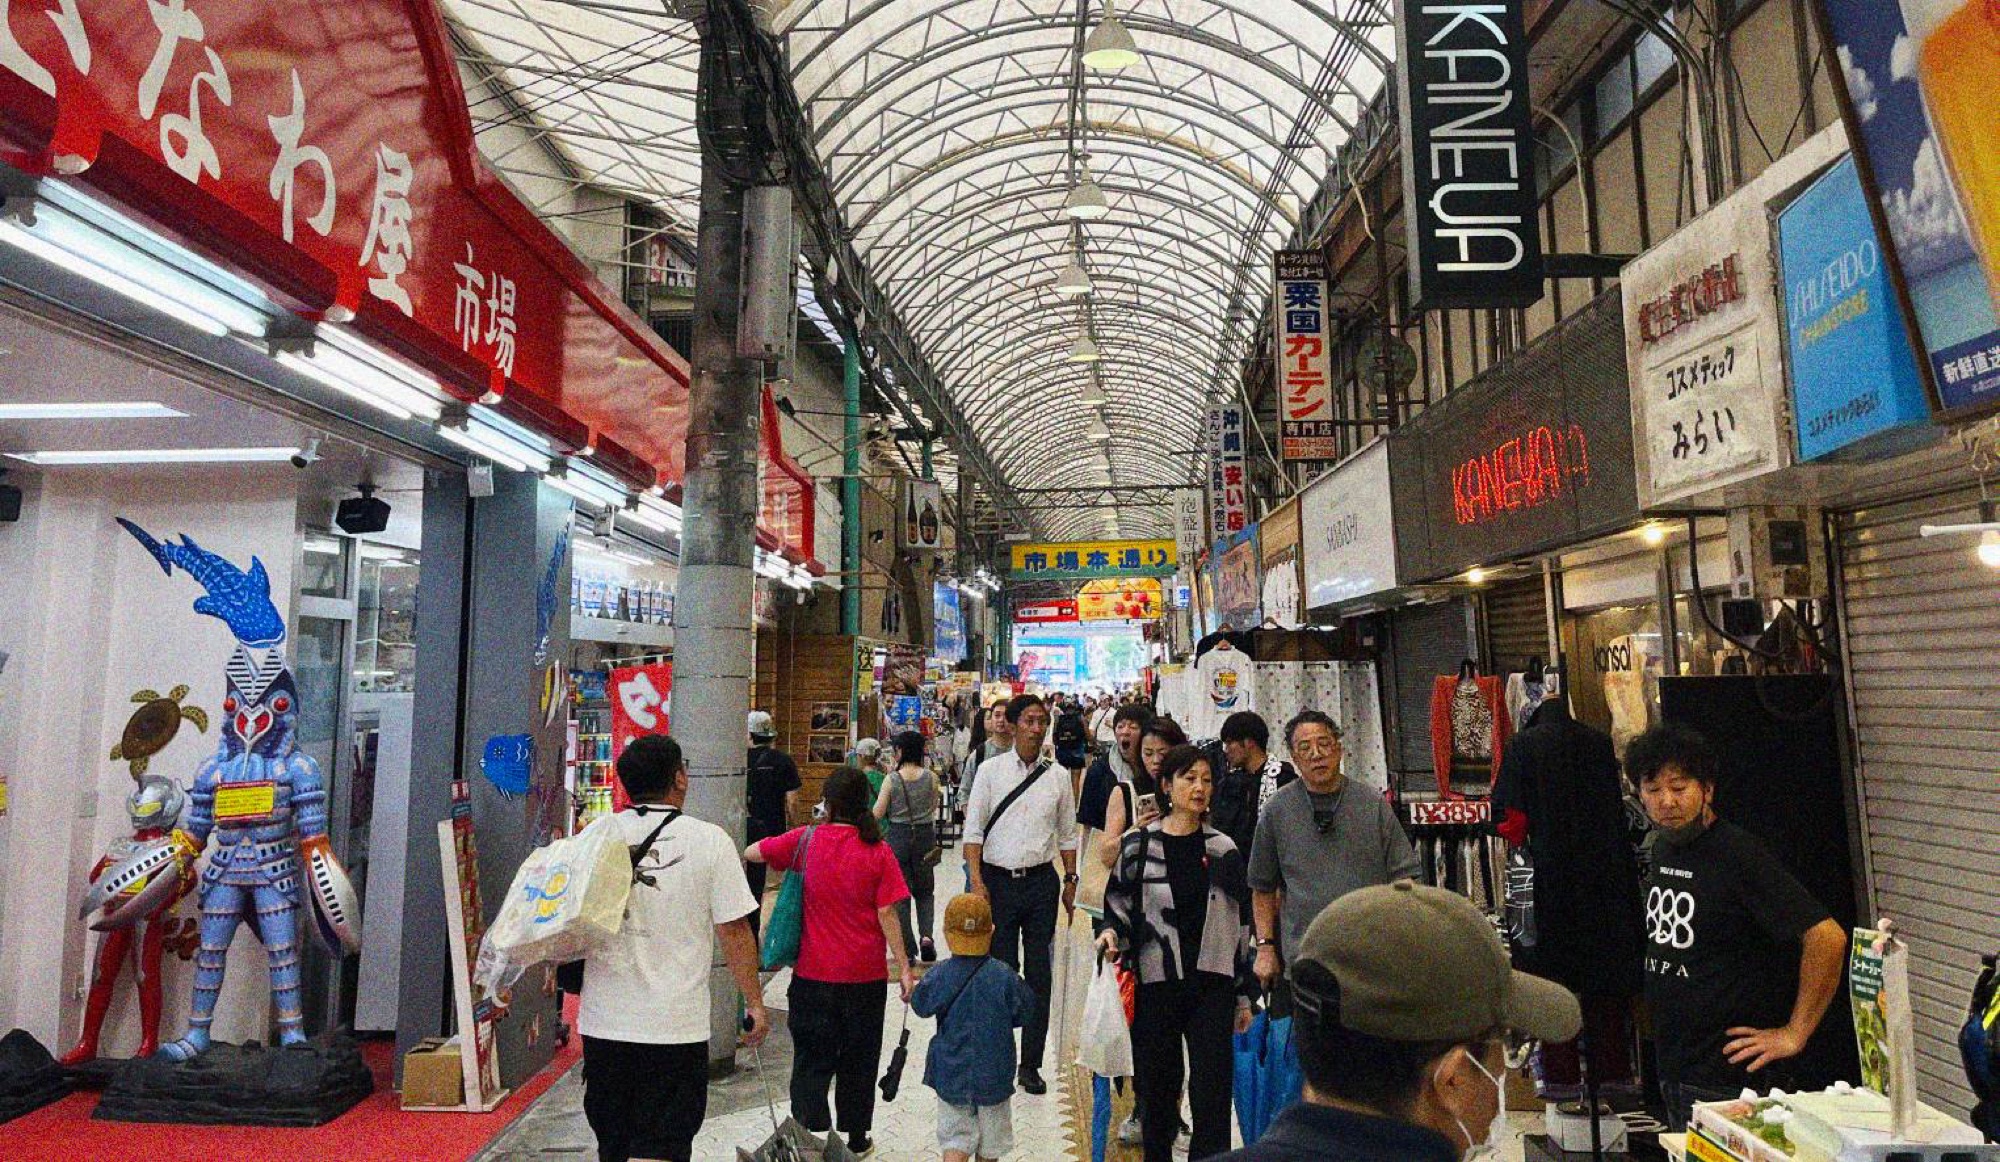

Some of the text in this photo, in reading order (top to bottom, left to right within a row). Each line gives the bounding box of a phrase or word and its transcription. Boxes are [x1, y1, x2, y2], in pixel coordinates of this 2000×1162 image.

[1422, 3, 1525, 273] KANEUA
[454, 242, 517, 378] 市場
[1790, 239, 1877, 328] SHISEIDO
[1284, 282, 1326, 419] 粟国カーテン
[1666, 345, 1735, 401] コスメティック
[1223, 409, 1245, 532] 沖縄一安い店
[1285, 421, 1332, 436] 専門店
[1671, 407, 1736, 460] みらい
[1023, 548, 1169, 573] 市場本通り
